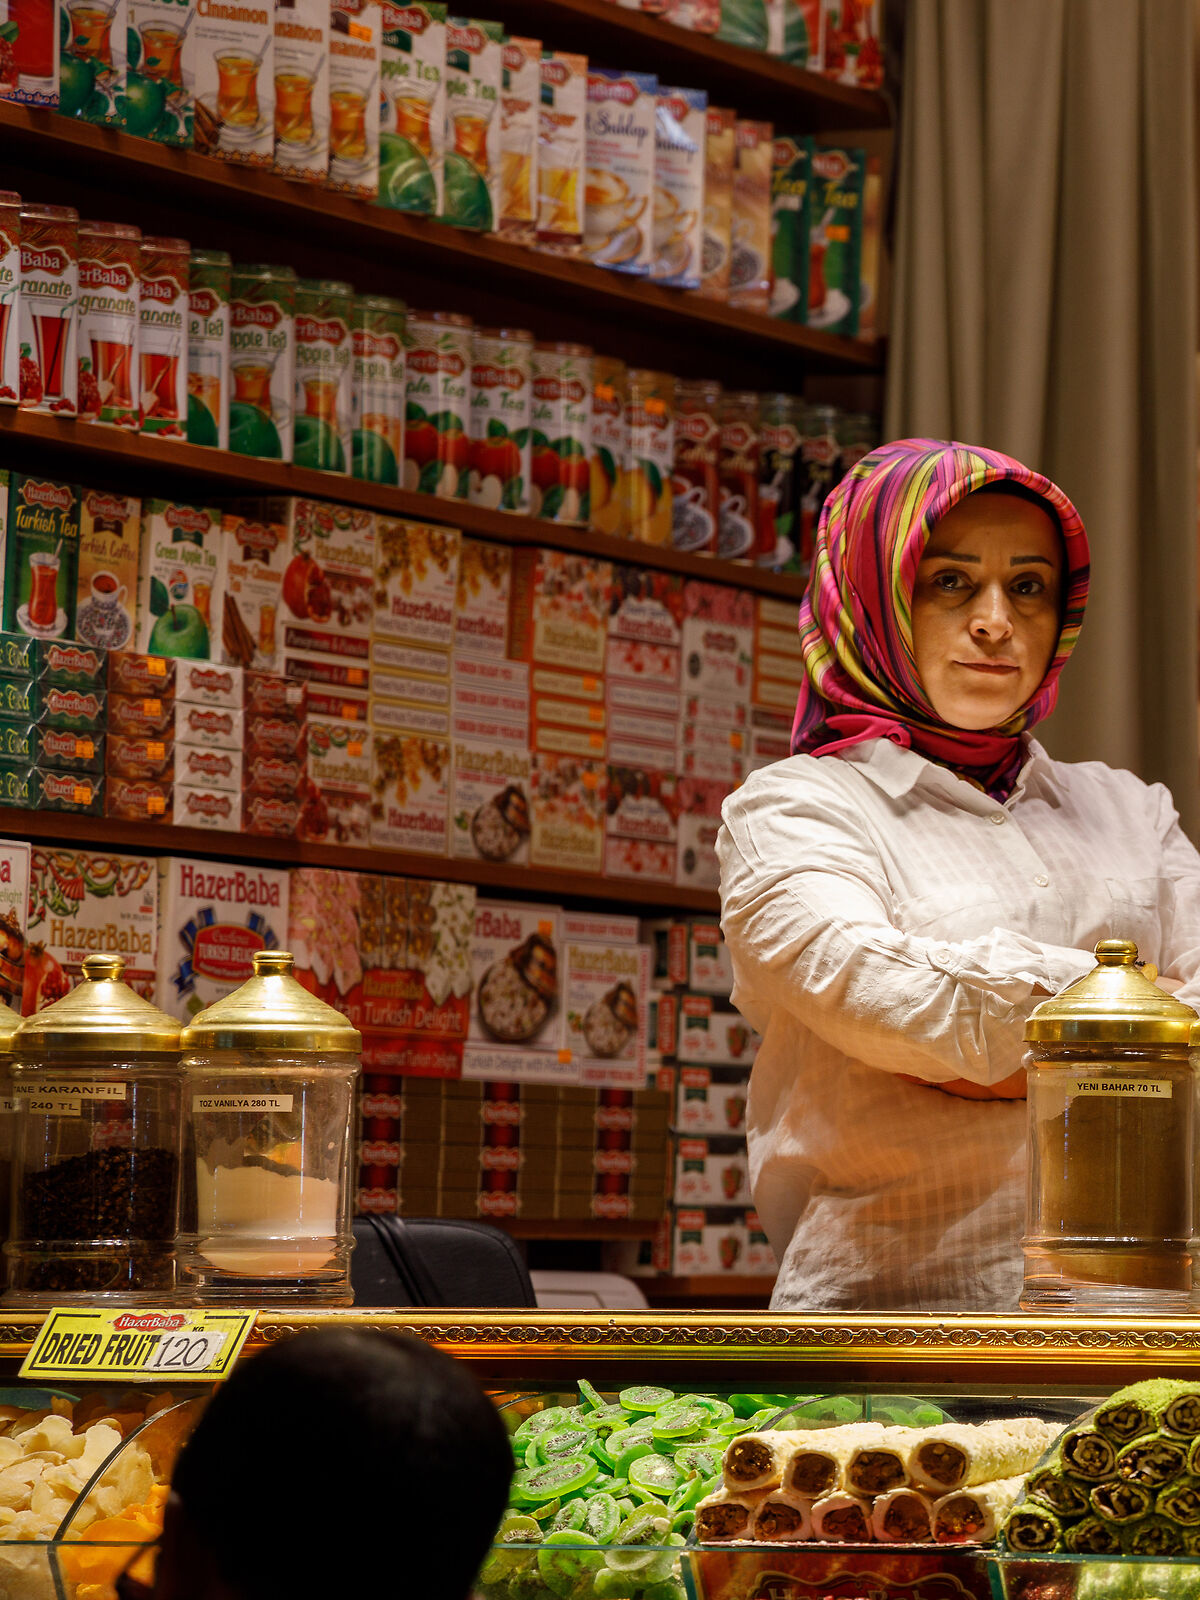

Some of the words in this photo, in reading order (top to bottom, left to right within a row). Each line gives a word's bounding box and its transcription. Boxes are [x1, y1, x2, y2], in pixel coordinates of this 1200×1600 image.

[20, 279, 72, 297] ranate
[80, 268, 126, 286] erBaba
[80, 295, 136, 316] granate
[16, 505, 56, 533] Turkish
[59, 513, 78, 538] Tea
[180, 864, 280, 907] HazerBaba
[50, 919, 153, 954] HazerBaba
[475, 911, 521, 939] rBaba
[363, 1001, 412, 1026] Turkish
[415, 1005, 462, 1032] Delight
[1077, 1083, 1099, 1092] YENI
[1101, 1083, 1135, 1092] BAHAR
[1137, 1083, 1149, 1092] 70
[1150, 1084, 1162, 1093] TL
[31, 1102, 53, 1110] 240
[58, 1103, 79, 1111] TL
[200, 1099, 213, 1108] TOZ
[214, 1099, 250, 1109] VANILYA
[251, 1099, 267, 1108] 280
[269, 1099, 280, 1108] TL
[119, 1315, 181, 1329] HazerBaba
[39, 1332, 102, 1364] DRIED
[153, 1336, 209, 1367] 120
